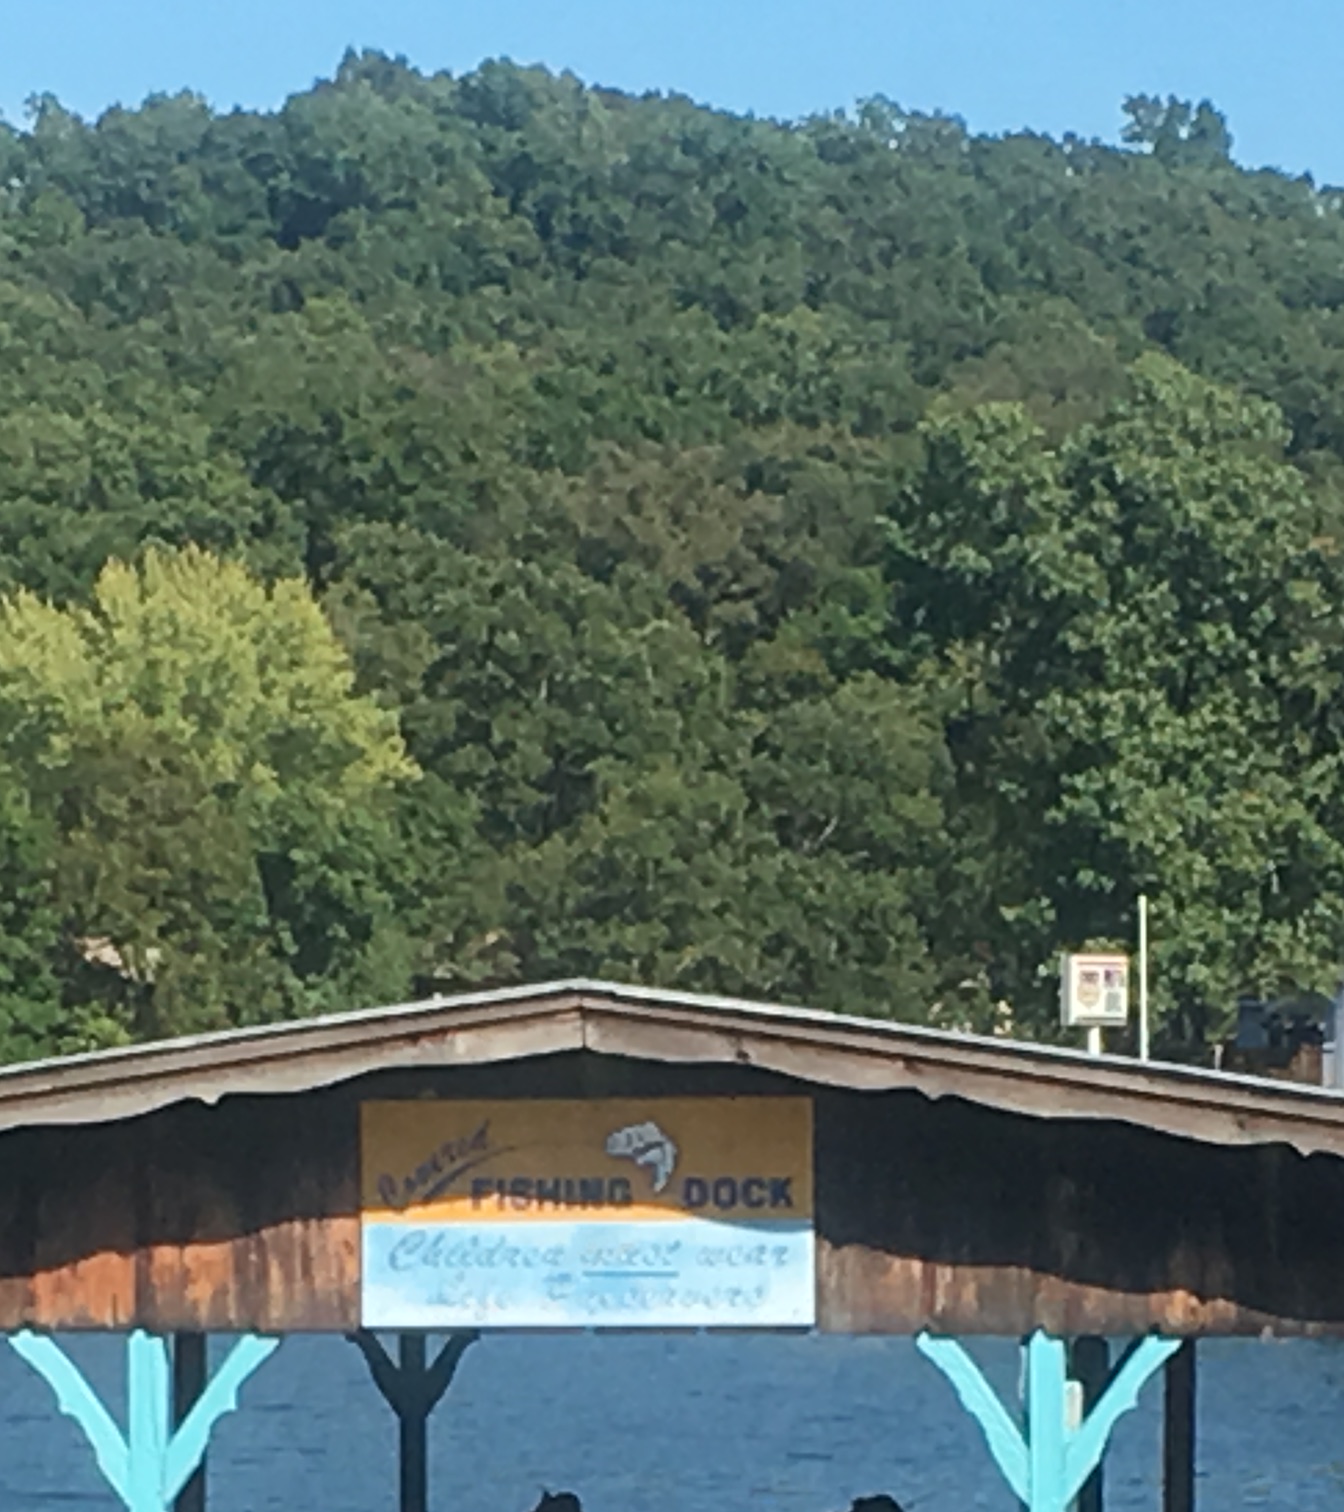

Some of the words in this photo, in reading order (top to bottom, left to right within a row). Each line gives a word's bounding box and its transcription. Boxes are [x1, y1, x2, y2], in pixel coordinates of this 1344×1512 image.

[471, 1177, 633, 1211] FISHING
[683, 1176, 795, 1210] DOCK
[388, 1229, 565, 1272] Children
[579, 1239, 682, 1269] must
[695, 1244, 789, 1269] wear
